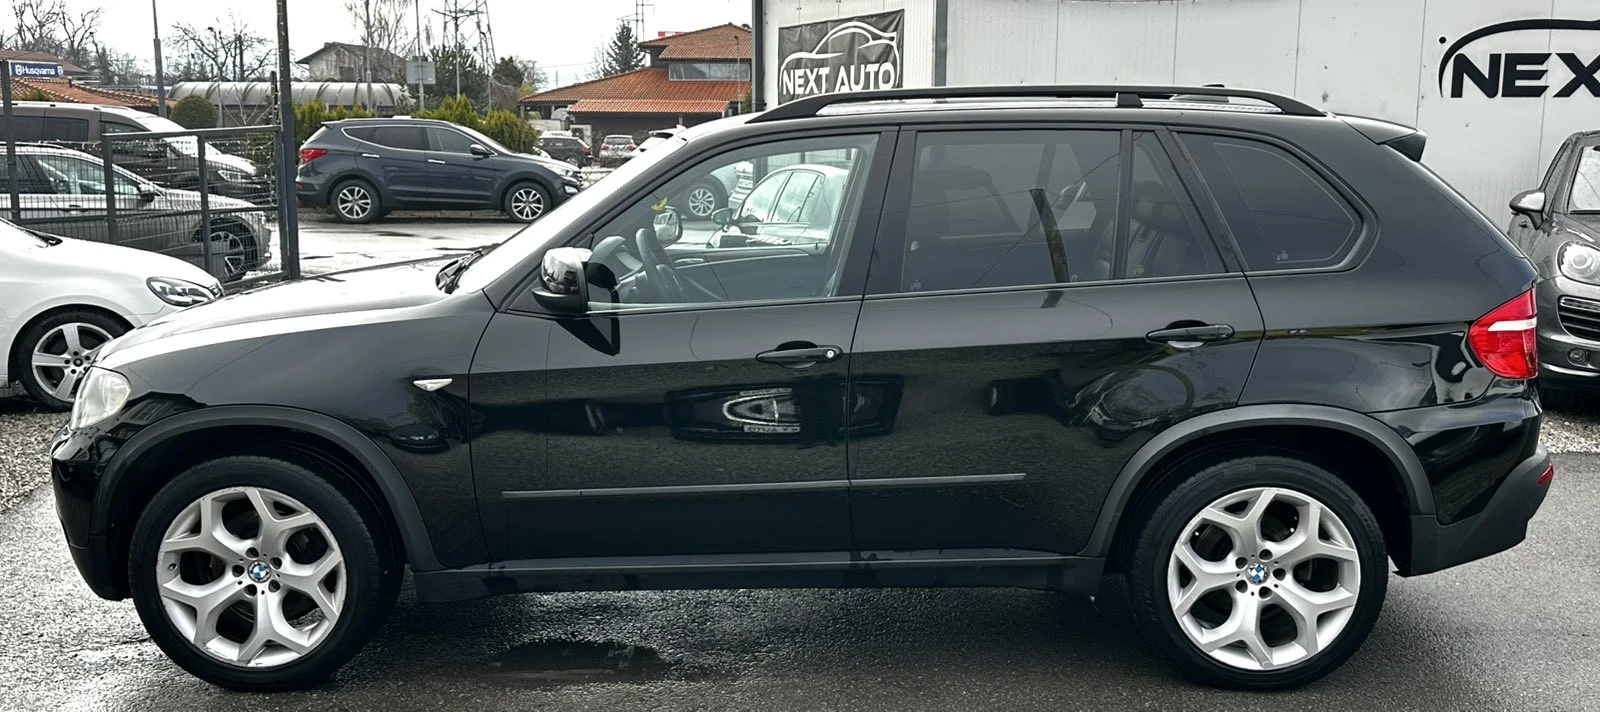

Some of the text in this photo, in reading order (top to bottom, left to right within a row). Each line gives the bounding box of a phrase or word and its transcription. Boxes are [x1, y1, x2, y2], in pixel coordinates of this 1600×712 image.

[22, 65, 56, 75] Husqvarna
[782, 62, 895, 95] NEXT AUTO
[1451, 53, 1600, 98] NEX
